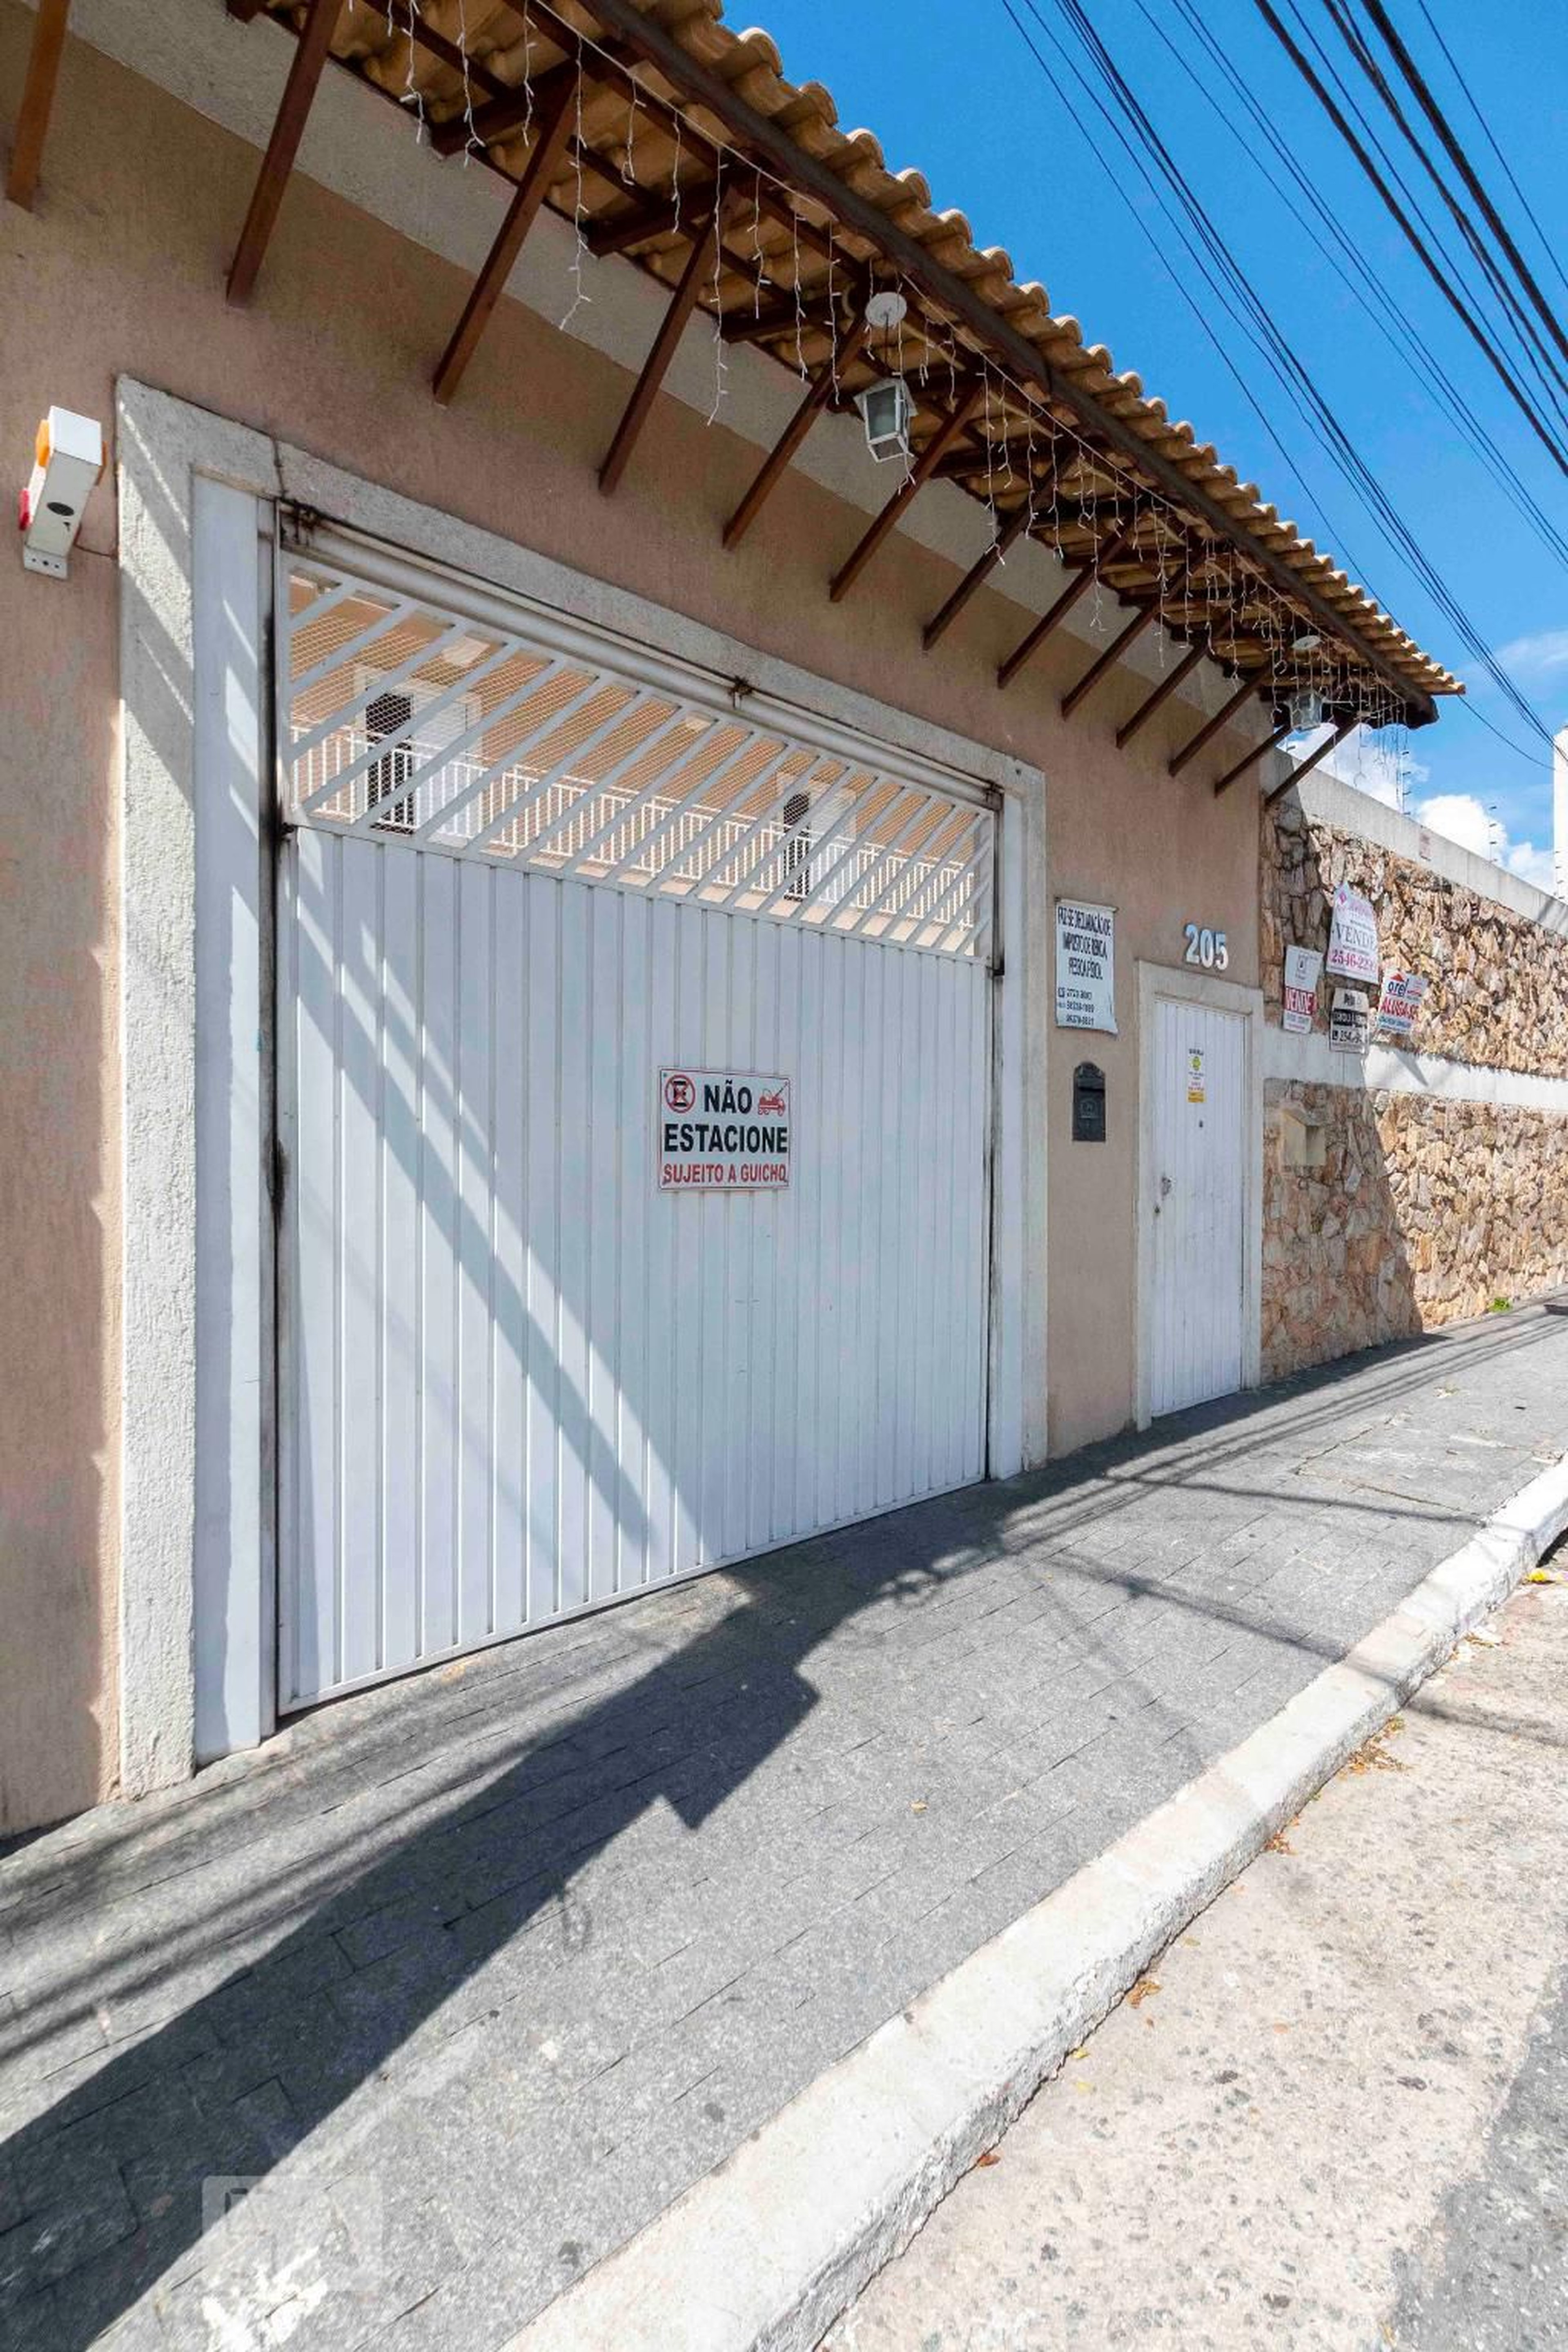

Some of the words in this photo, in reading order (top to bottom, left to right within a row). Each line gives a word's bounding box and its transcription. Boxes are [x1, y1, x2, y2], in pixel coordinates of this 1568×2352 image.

[1184, 924, 1228, 970] 205
[704, 1079, 752, 1114] NÃO
[664, 1124, 787, 1153] ESTACIONE
[664, 1164, 723, 1183] SUJEITO
[728, 1164, 736, 1183] A
